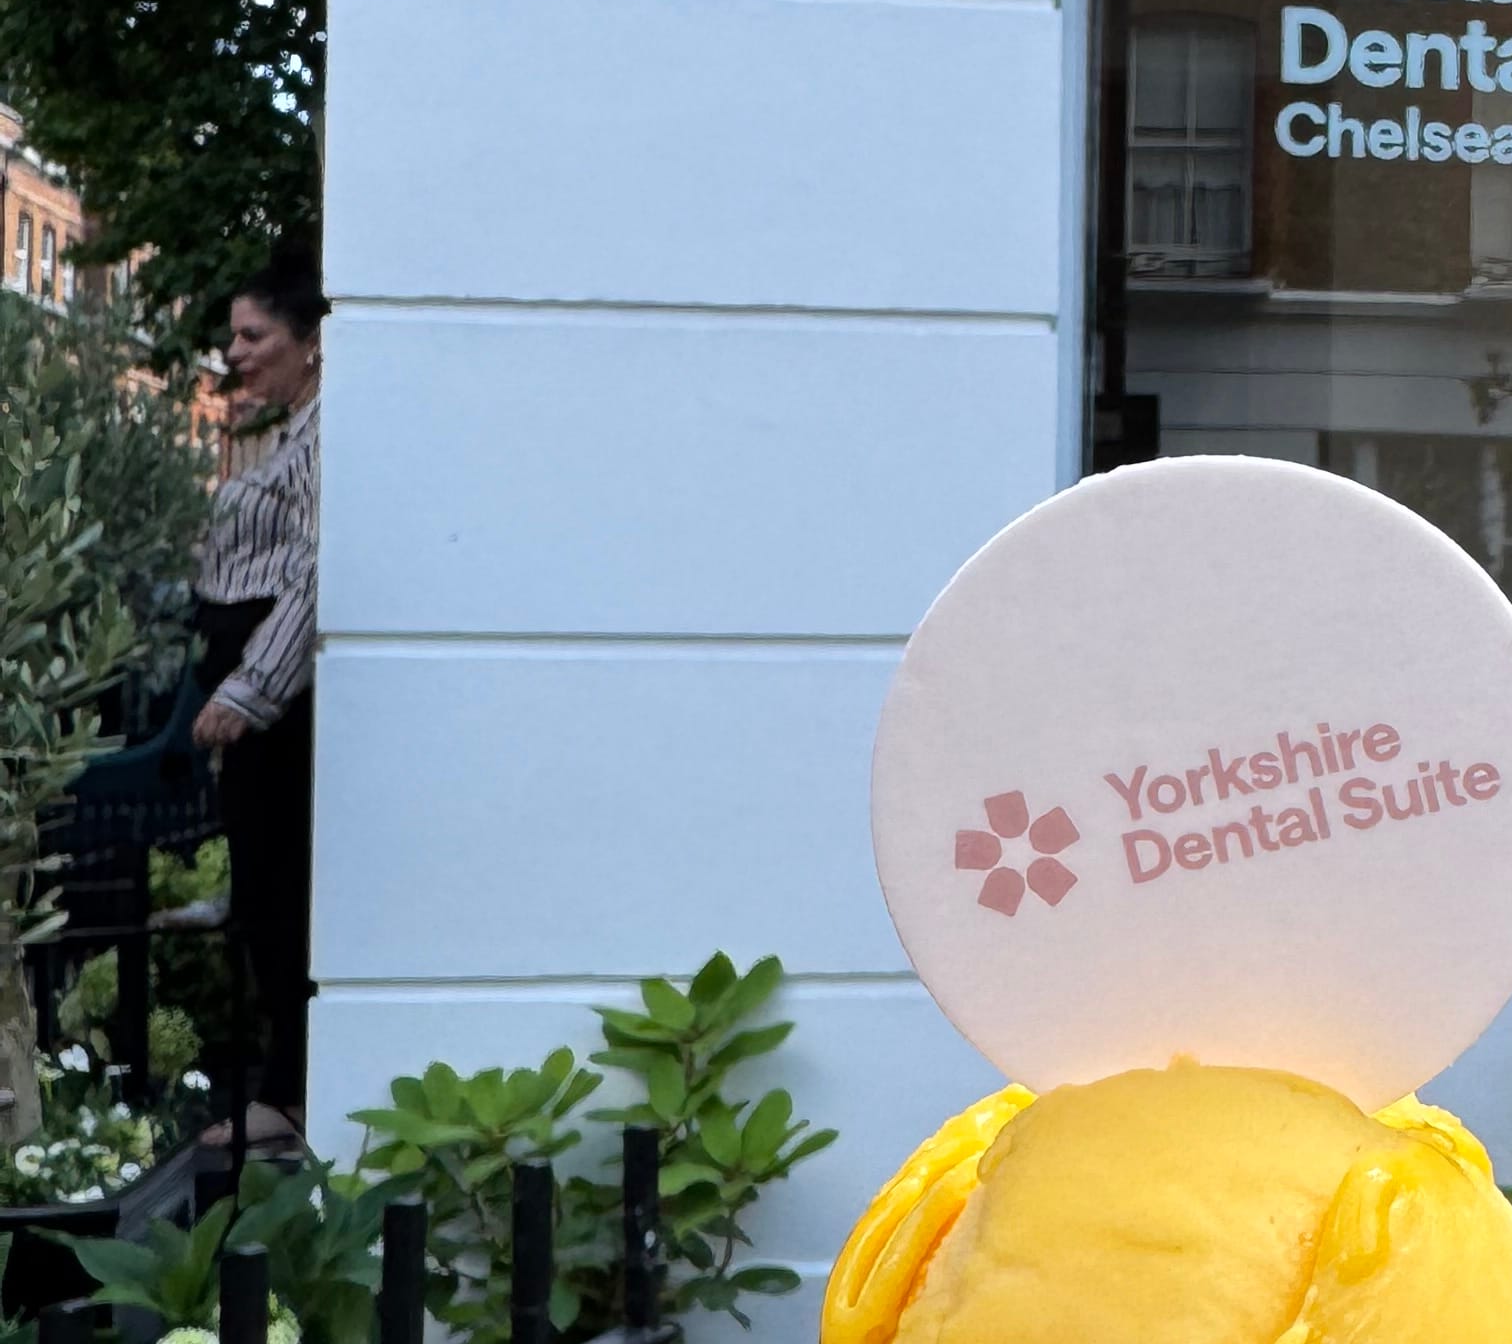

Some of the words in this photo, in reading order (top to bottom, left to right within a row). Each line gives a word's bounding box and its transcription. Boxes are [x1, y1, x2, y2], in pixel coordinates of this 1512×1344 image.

[1104, 721, 1402, 820] Yorkshire
[1121, 787, 1332, 885] Dental
[1337, 761, 1502, 830] Suite
